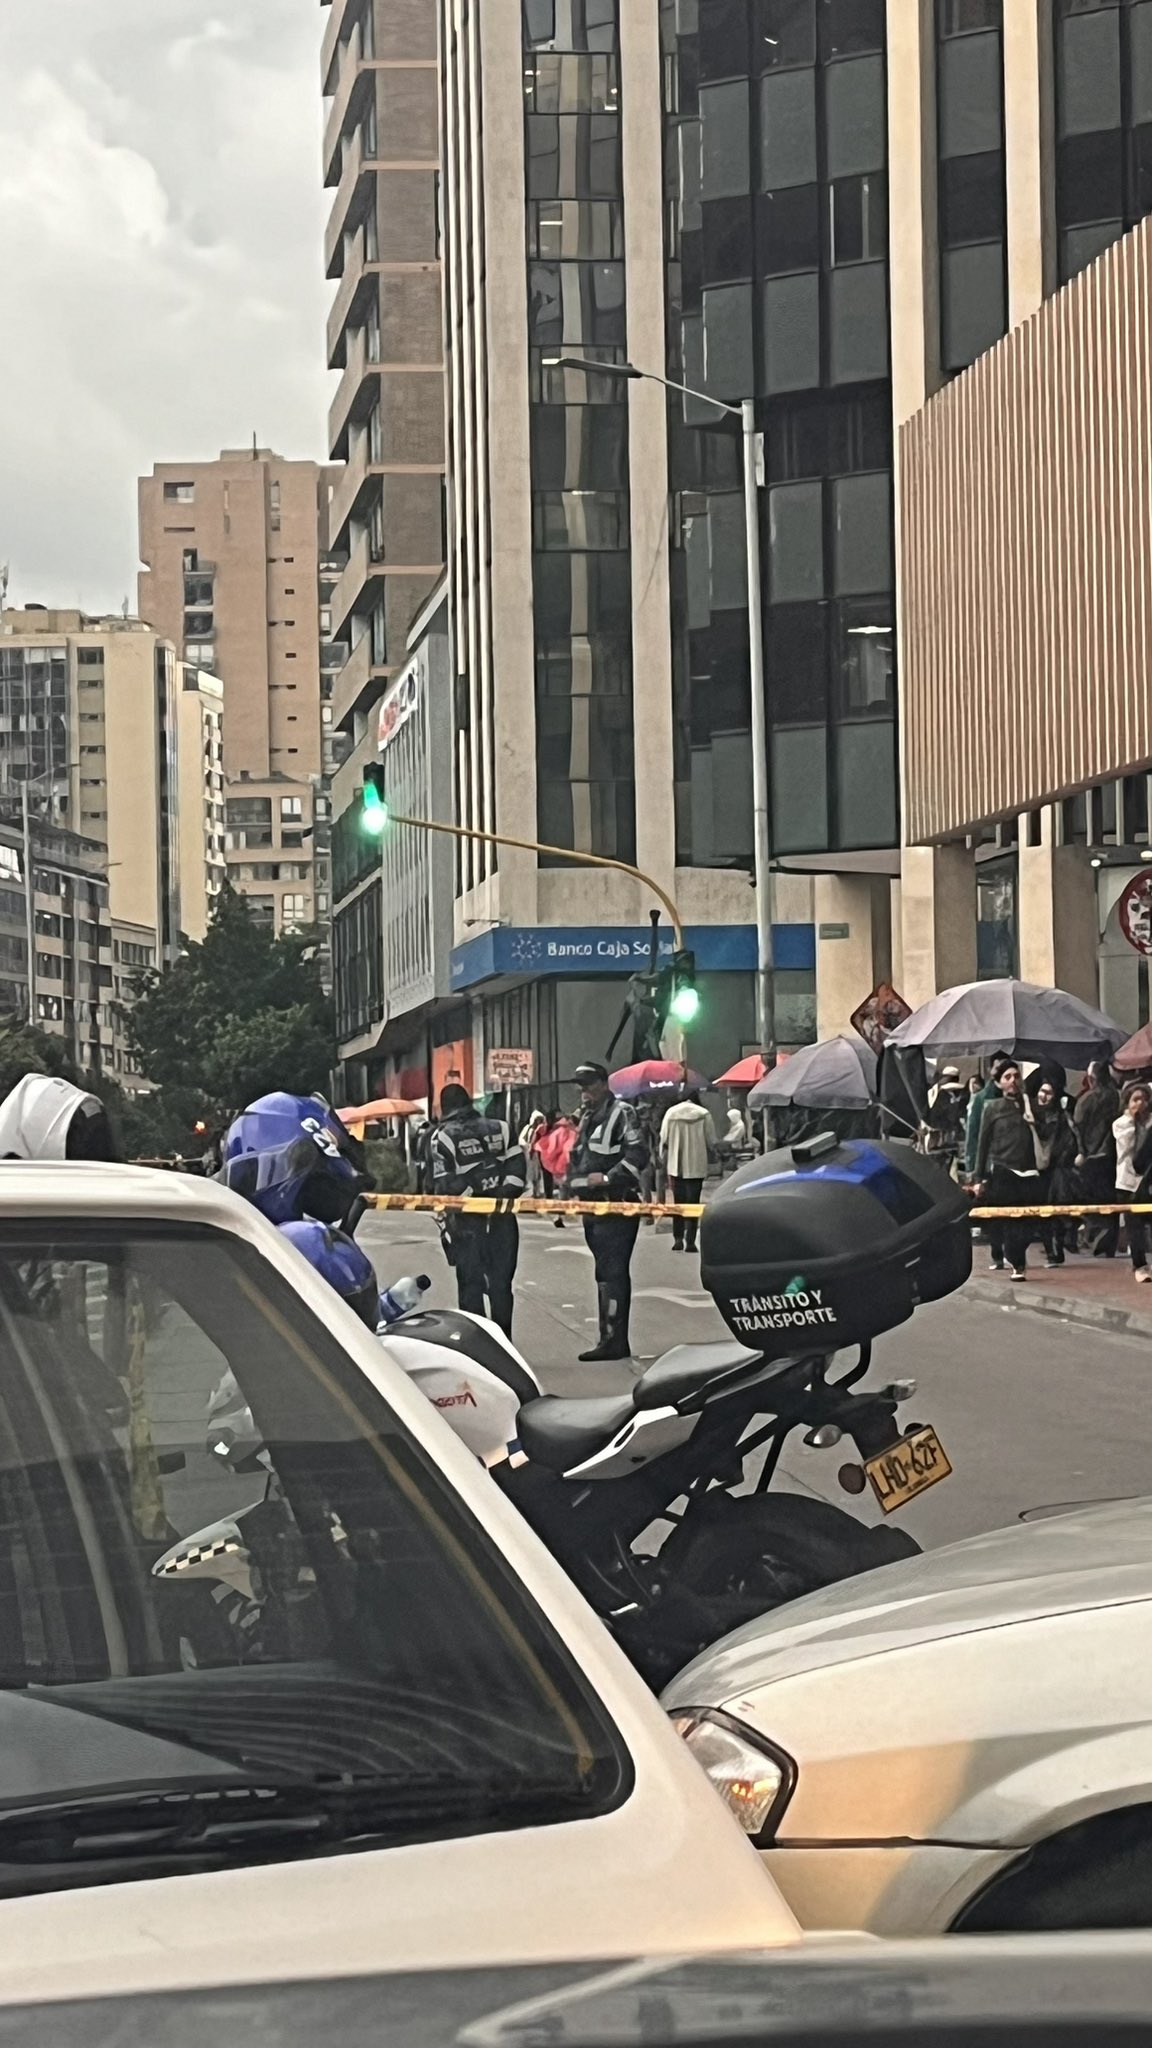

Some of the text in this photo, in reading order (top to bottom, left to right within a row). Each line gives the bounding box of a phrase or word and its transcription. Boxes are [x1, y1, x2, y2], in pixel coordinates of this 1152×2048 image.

[547, 942, 592, 956] Banco
[597, 941, 630, 958] Caja
[811, 1290, 822, 1305] Y
[732, 1307, 837, 1331] TRANSPORTE
